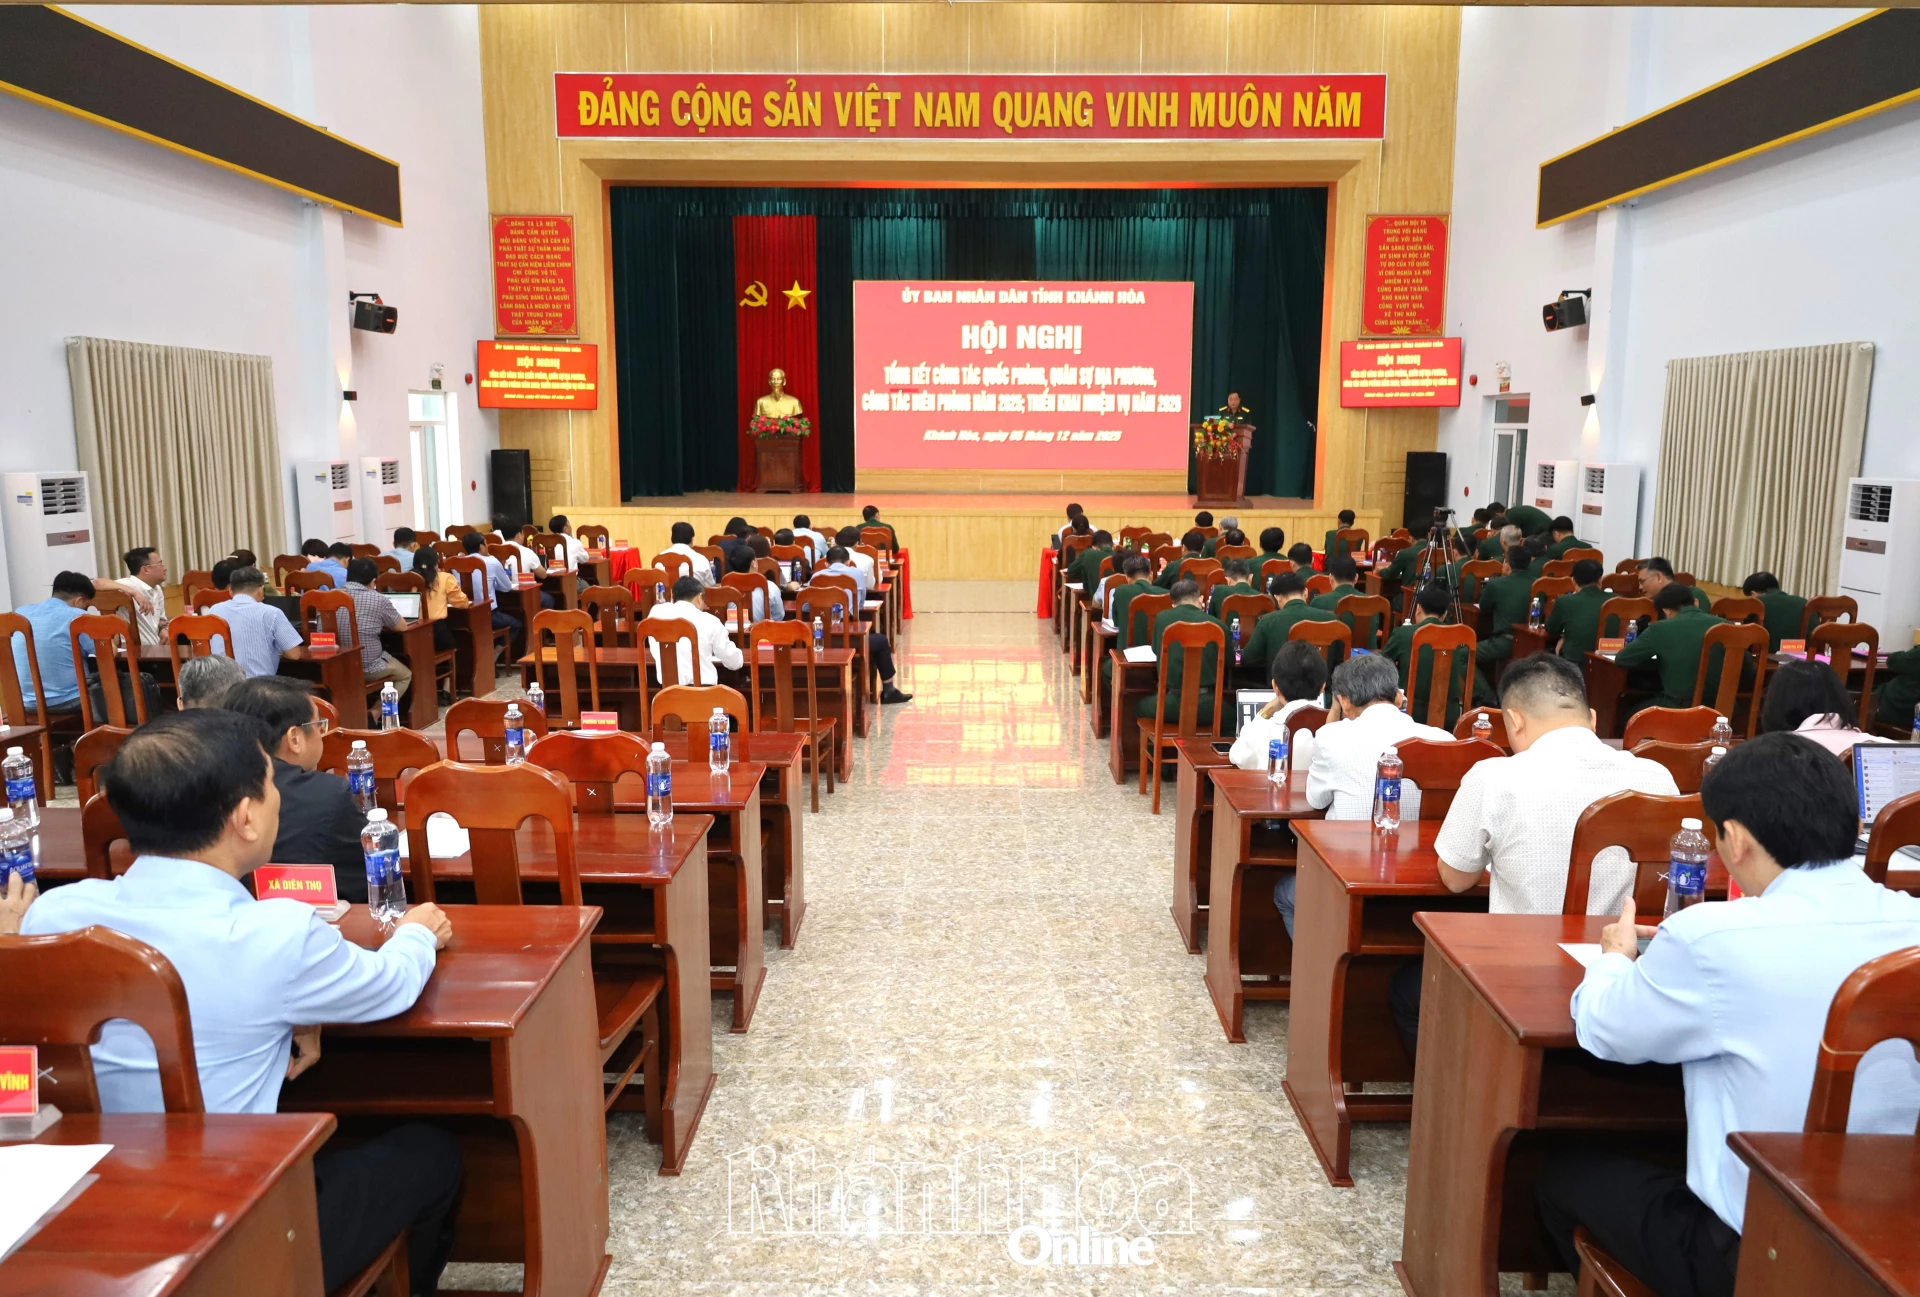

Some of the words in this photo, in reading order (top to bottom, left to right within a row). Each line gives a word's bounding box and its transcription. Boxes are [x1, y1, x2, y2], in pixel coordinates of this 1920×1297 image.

[579, 77, 660, 126] ĐẢNG
[671, 82, 751, 133] CỘNG
[763, 78, 821, 126] SẢN
[834, 83, 901, 132] VIỆT
[914, 92, 980, 127] NAM
[993, 90, 1093, 134] QUANG
[1105, 92, 1178, 127] VINH
[1190, 83, 1281, 127] MUÔN
[1293, 85, 1361, 127] NĂM
[924, 291, 953, 303] BAN
[956, 288, 995, 303] NHÂN
[999, 288, 1028, 303] DÂN
[1031, 287, 1063, 303] TỈNH
[1066, 288, 1114, 304] KHÁNH
[961, 320, 1007, 354] HỘI
[1017, 325, 1082, 354] NGHỊ
[1056, 431, 1070, 441] 12
[268, 878, 281, 890] XÃ
[283, 879, 303, 890] DIÊN
[306, 880, 322, 892] THỌ
[0, 1070, 29, 1090] VĨNH
